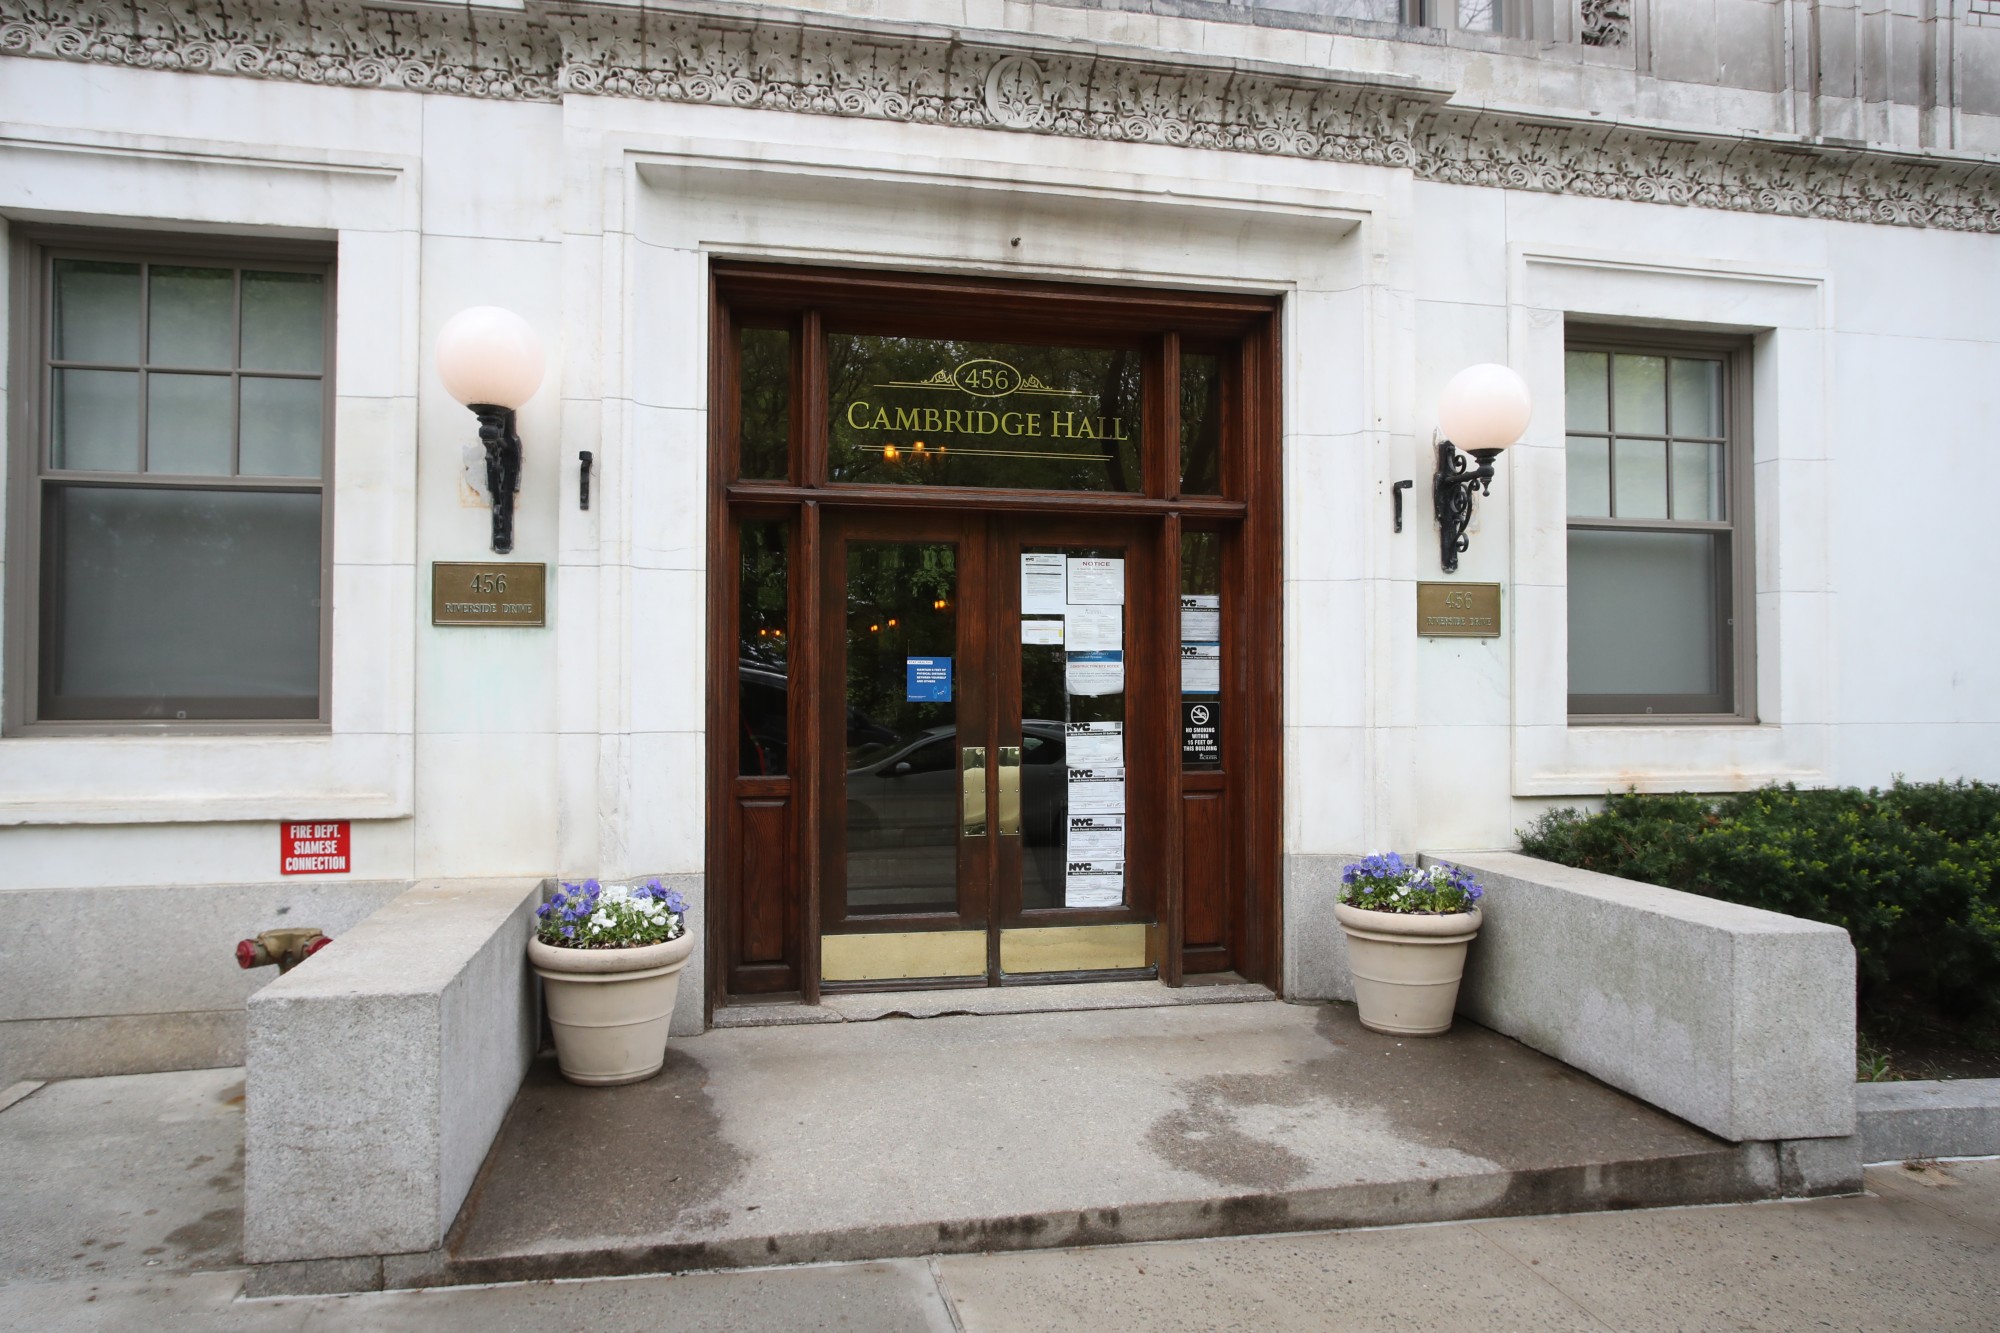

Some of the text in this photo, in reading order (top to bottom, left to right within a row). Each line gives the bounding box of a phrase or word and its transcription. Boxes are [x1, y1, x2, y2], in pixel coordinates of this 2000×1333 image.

[965, 368, 1009, 390] 456
[847, 401, 1128, 441] CAMBRIDGE HALL
[470, 573, 507, 593] 456
[1445, 591, 1472, 609] 456
[444, 602, 533, 614] RIVERSIDE DRIVE
[1426, 616, 1466, 626] RIVERSIDE
[1067, 723, 1091, 732] NYC
[1070, 769, 1093, 778] NYC
[1071, 818, 1093, 827] NYC
[290, 824, 341, 839] FIRE DEPT.
[294, 840, 337, 855] SIAMESE
[285, 856, 346, 871] CONNECTION
[1069, 862, 1091, 871] NYC
